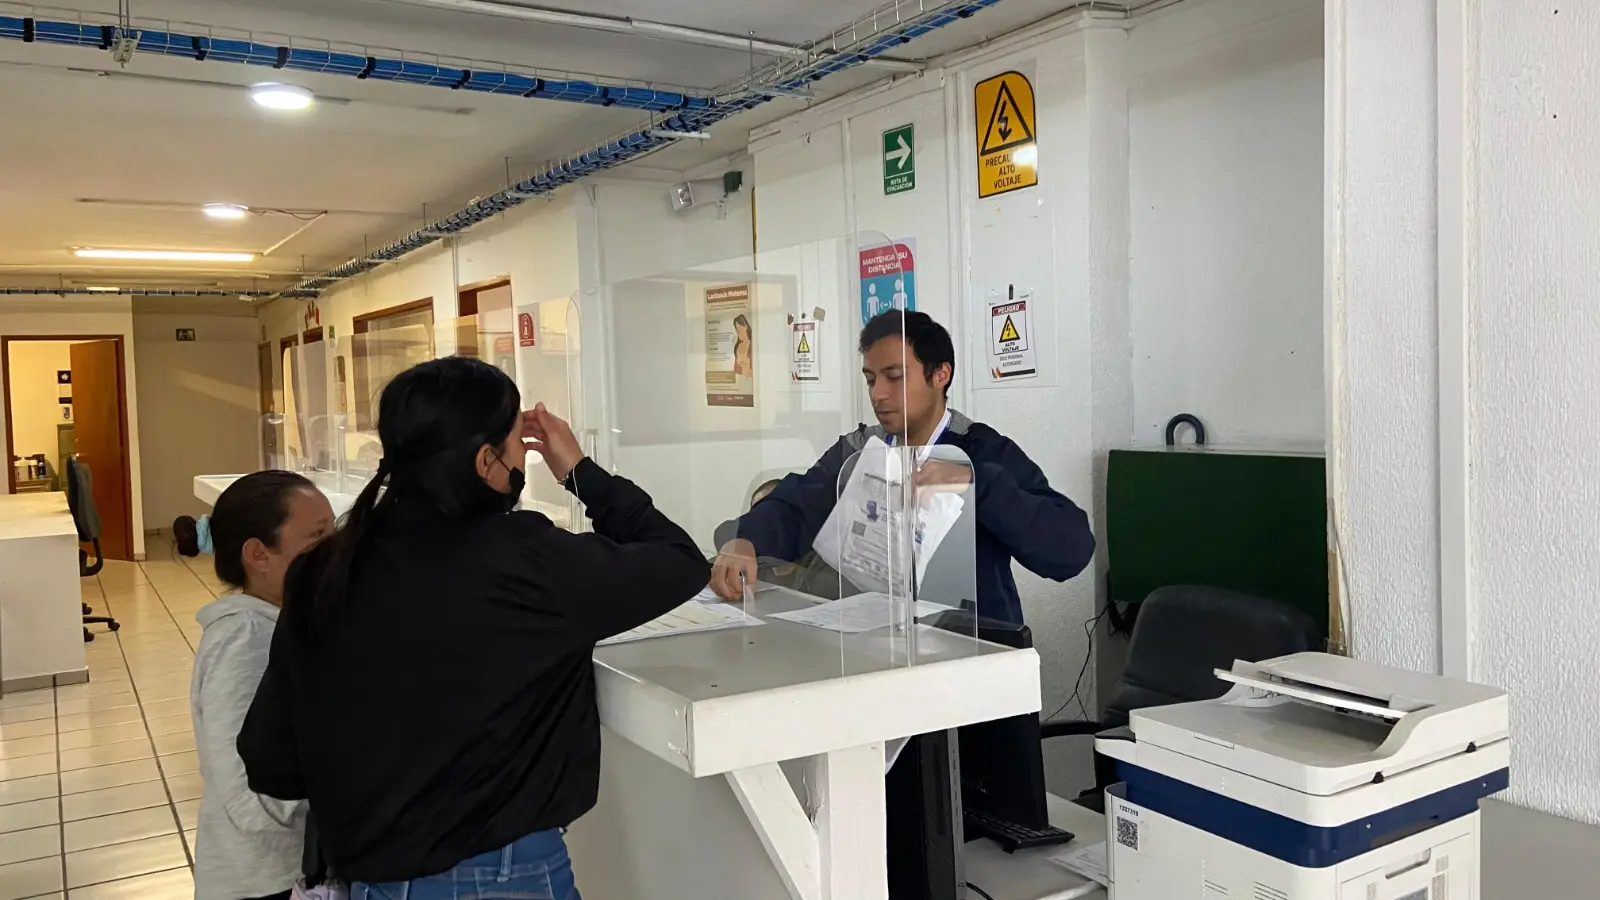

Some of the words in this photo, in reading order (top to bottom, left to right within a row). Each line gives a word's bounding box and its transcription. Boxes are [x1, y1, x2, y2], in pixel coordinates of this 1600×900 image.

[999, 164, 1015, 176] ALTO
[993, 174, 1021, 189] VOLTAJE
[862, 254, 895, 266] MANTENGA
[897, 252, 908, 260] SU
[868, 261, 901, 273] DISTANCIA
[997, 304, 1020, 314] PELIGRO
